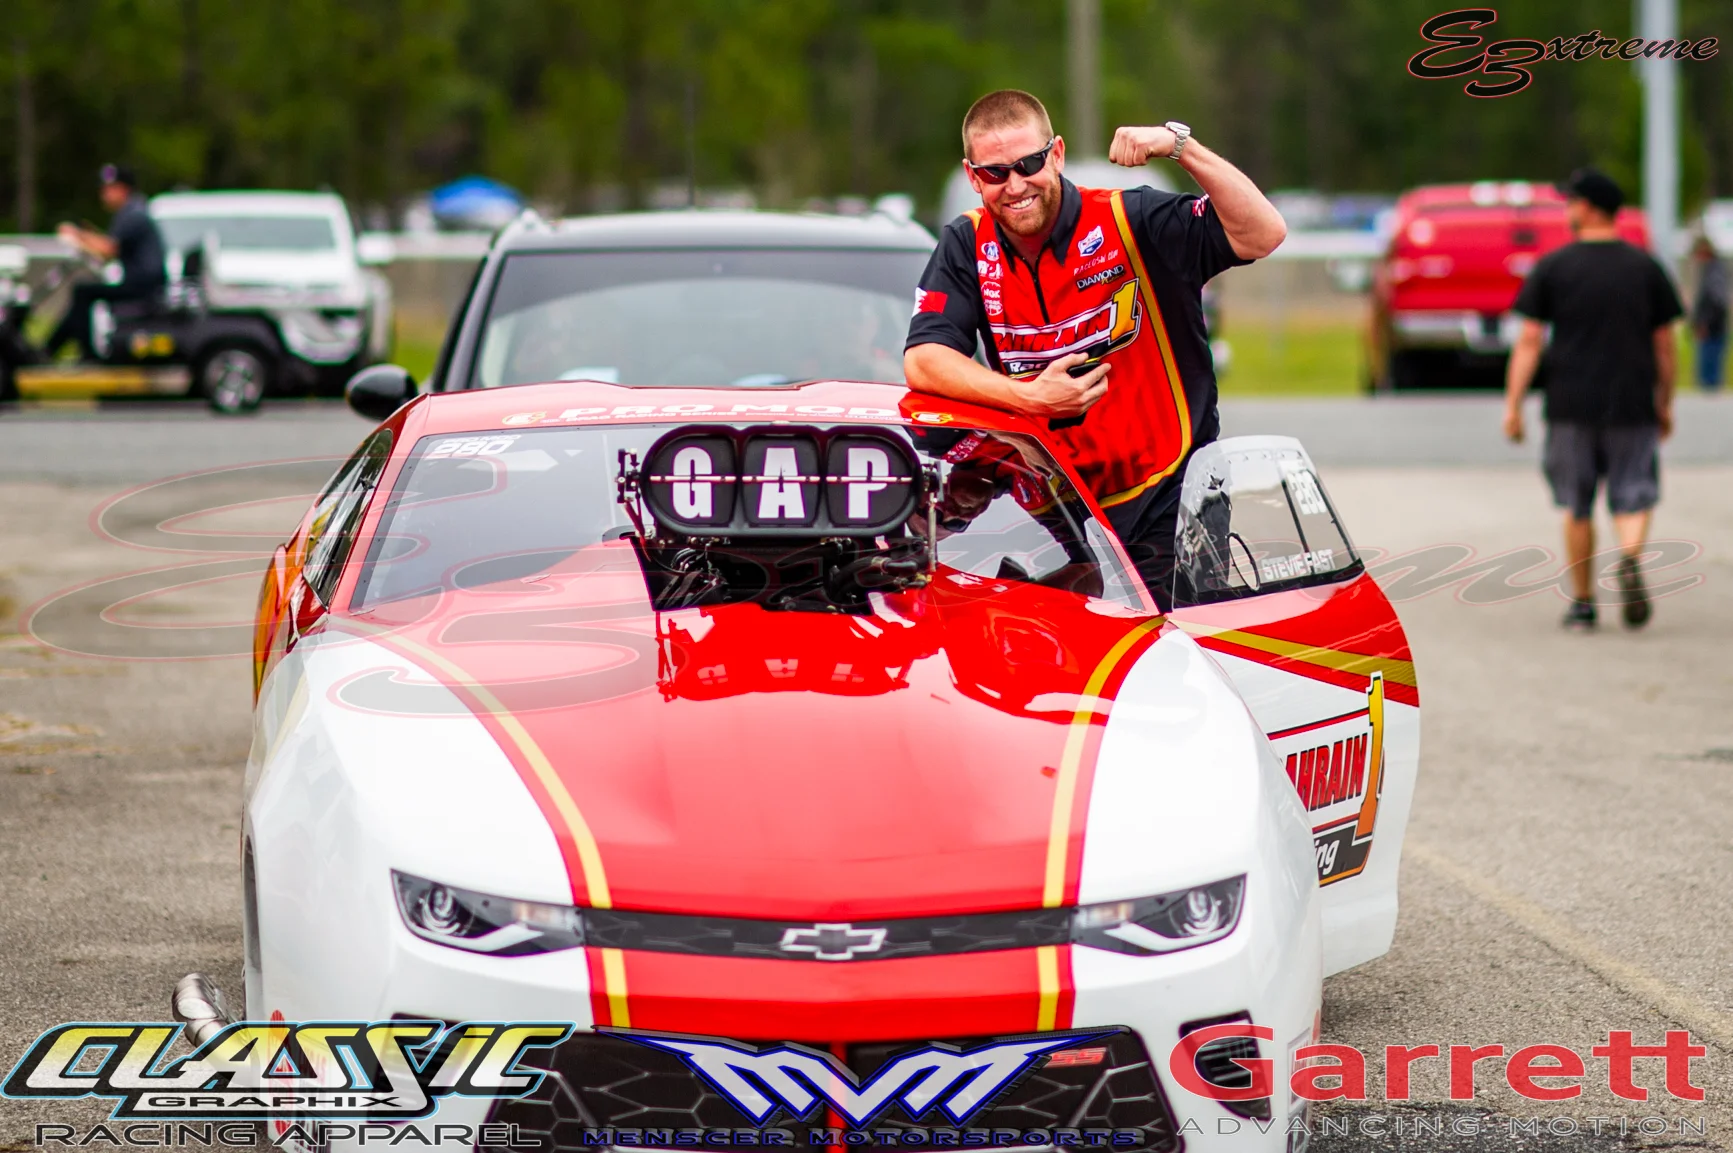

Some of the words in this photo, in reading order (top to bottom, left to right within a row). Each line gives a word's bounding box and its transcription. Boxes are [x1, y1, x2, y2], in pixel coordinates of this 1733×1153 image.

[1077, 265, 1124, 289] DIAMOND
[984, 288, 1000, 298] NGK
[992, 307, 1111, 352] AHRAIN
[1010, 361, 1048, 373] Rac
[559, 404, 715, 419] PRO
[731, 404, 897, 417] MOD
[425, 439, 515, 460] 280
[671, 446, 890, 519] GAP
[1262, 554, 1306, 581] STEVIE
[1303, 549, 1335, 575] FAST
[1284, 732, 1368, 812] AHRAIN
